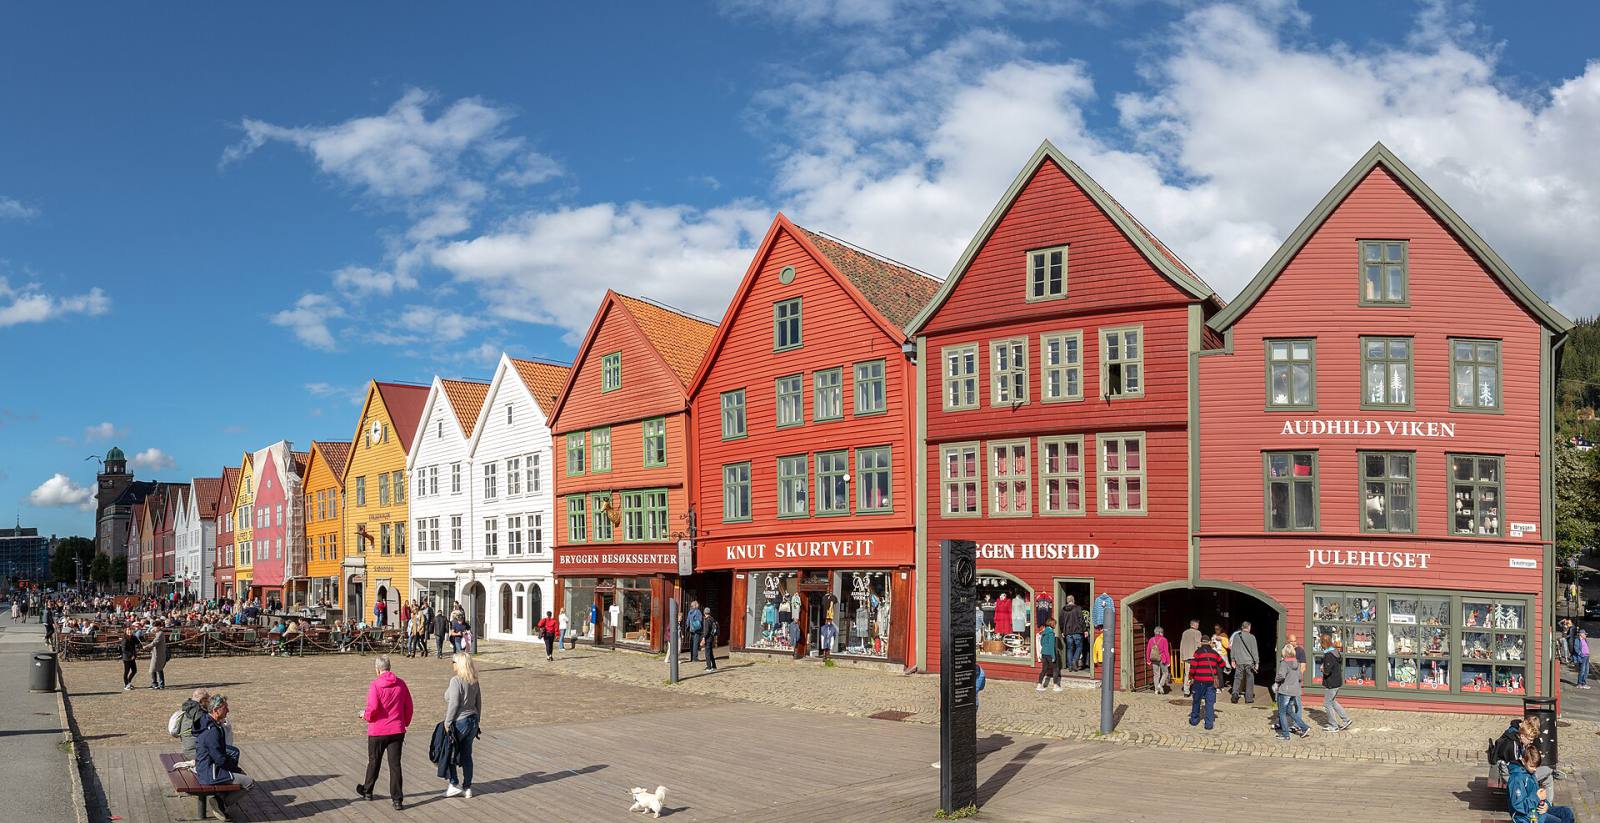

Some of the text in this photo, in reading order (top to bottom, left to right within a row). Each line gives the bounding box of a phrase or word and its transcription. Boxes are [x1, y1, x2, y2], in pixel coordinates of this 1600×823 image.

[1280, 420, 1456, 438] AUDHILD VIKEN
[726, 539, 874, 560] KNUT SKURTVEIT
[1021, 543, 1100, 560] HUSFLID
[559, 554, 599, 565] BRYGGEN
[602, 553, 678, 565] BESØKSSENTER
[1305, 549, 1431, 569] JULEHUSET
